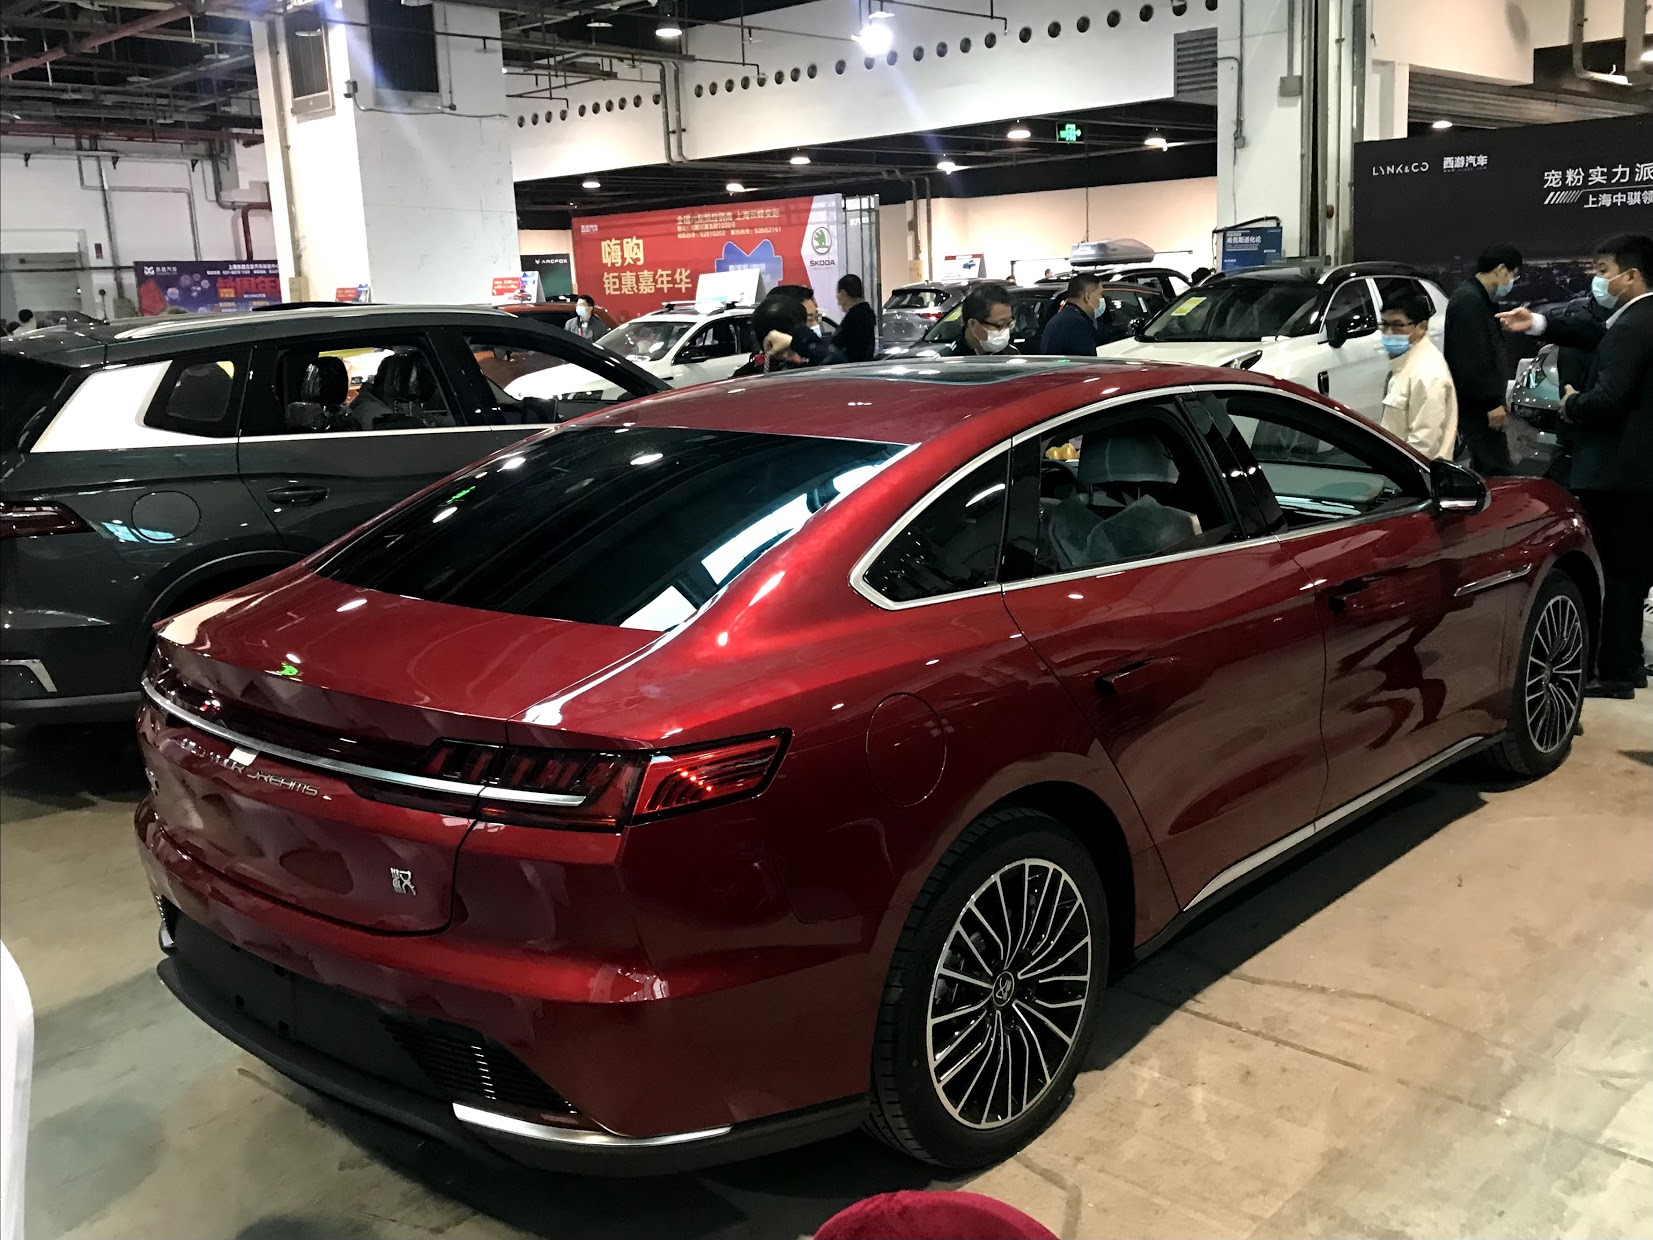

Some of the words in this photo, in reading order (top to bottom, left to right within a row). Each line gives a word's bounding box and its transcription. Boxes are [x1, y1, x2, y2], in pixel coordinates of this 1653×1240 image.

[1543, 162, 1653, 189] 宠粉实力派
[601, 236, 645, 267] 嗨购
[602, 267, 693, 296] 钜惠嘉年华
